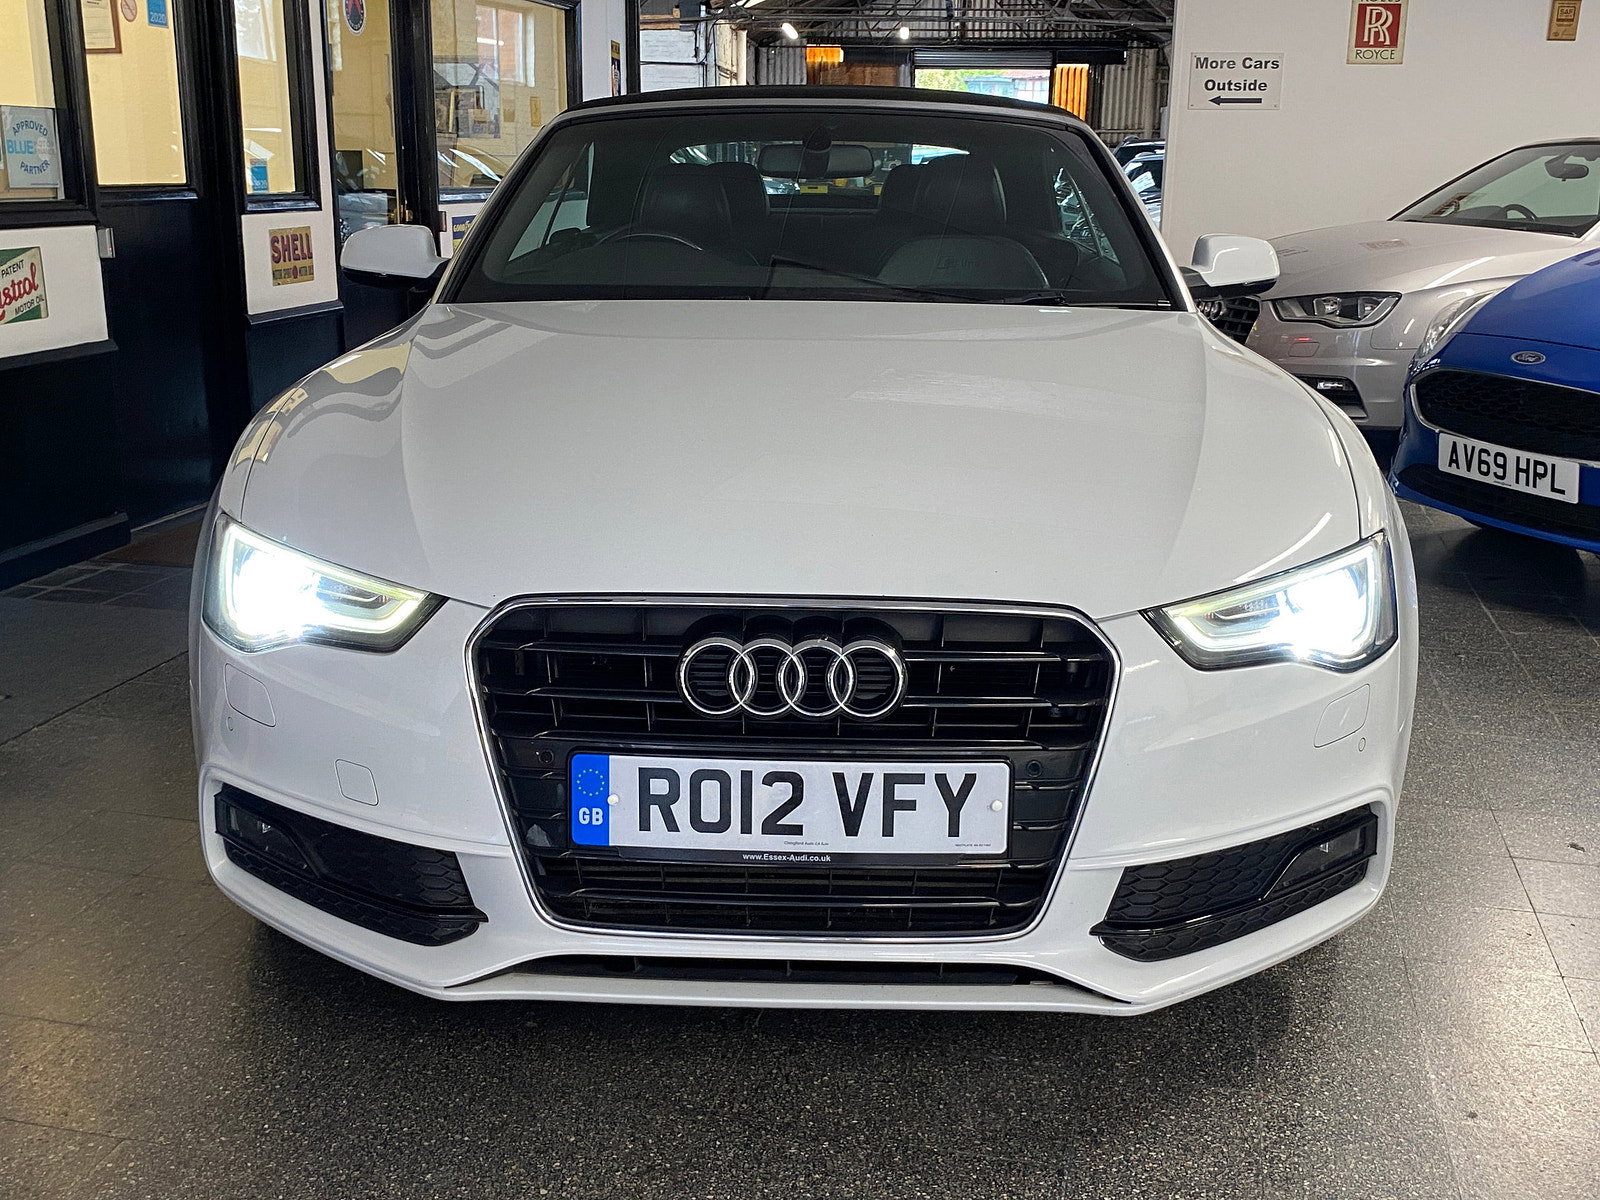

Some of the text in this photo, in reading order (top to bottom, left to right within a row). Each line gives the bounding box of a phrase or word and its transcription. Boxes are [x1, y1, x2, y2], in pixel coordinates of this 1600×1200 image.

[150, 12, 167, 24] 2020
[1355, 49, 1396, 60] ROYCE
[1195, 57, 1280, 69] More Cars
[1204, 79, 1268, 91] Outside
[12, 120, 49, 137] APPROVED
[6, 139, 34, 155] BLUE
[20, 160, 51, 175] PARTNER
[271, 233, 313, 264] SHELL
[1, 259, 24, 279] PATENT
[14, 294, 45, 315] MOTOR OIL
[1448, 441, 1566, 495] AV69 HPL
[638, 766, 977, 838] RO12 VFY
[578, 807, 603, 826] GB
[742, 853, 831, 862] www.Essex-Audi.co.uk
